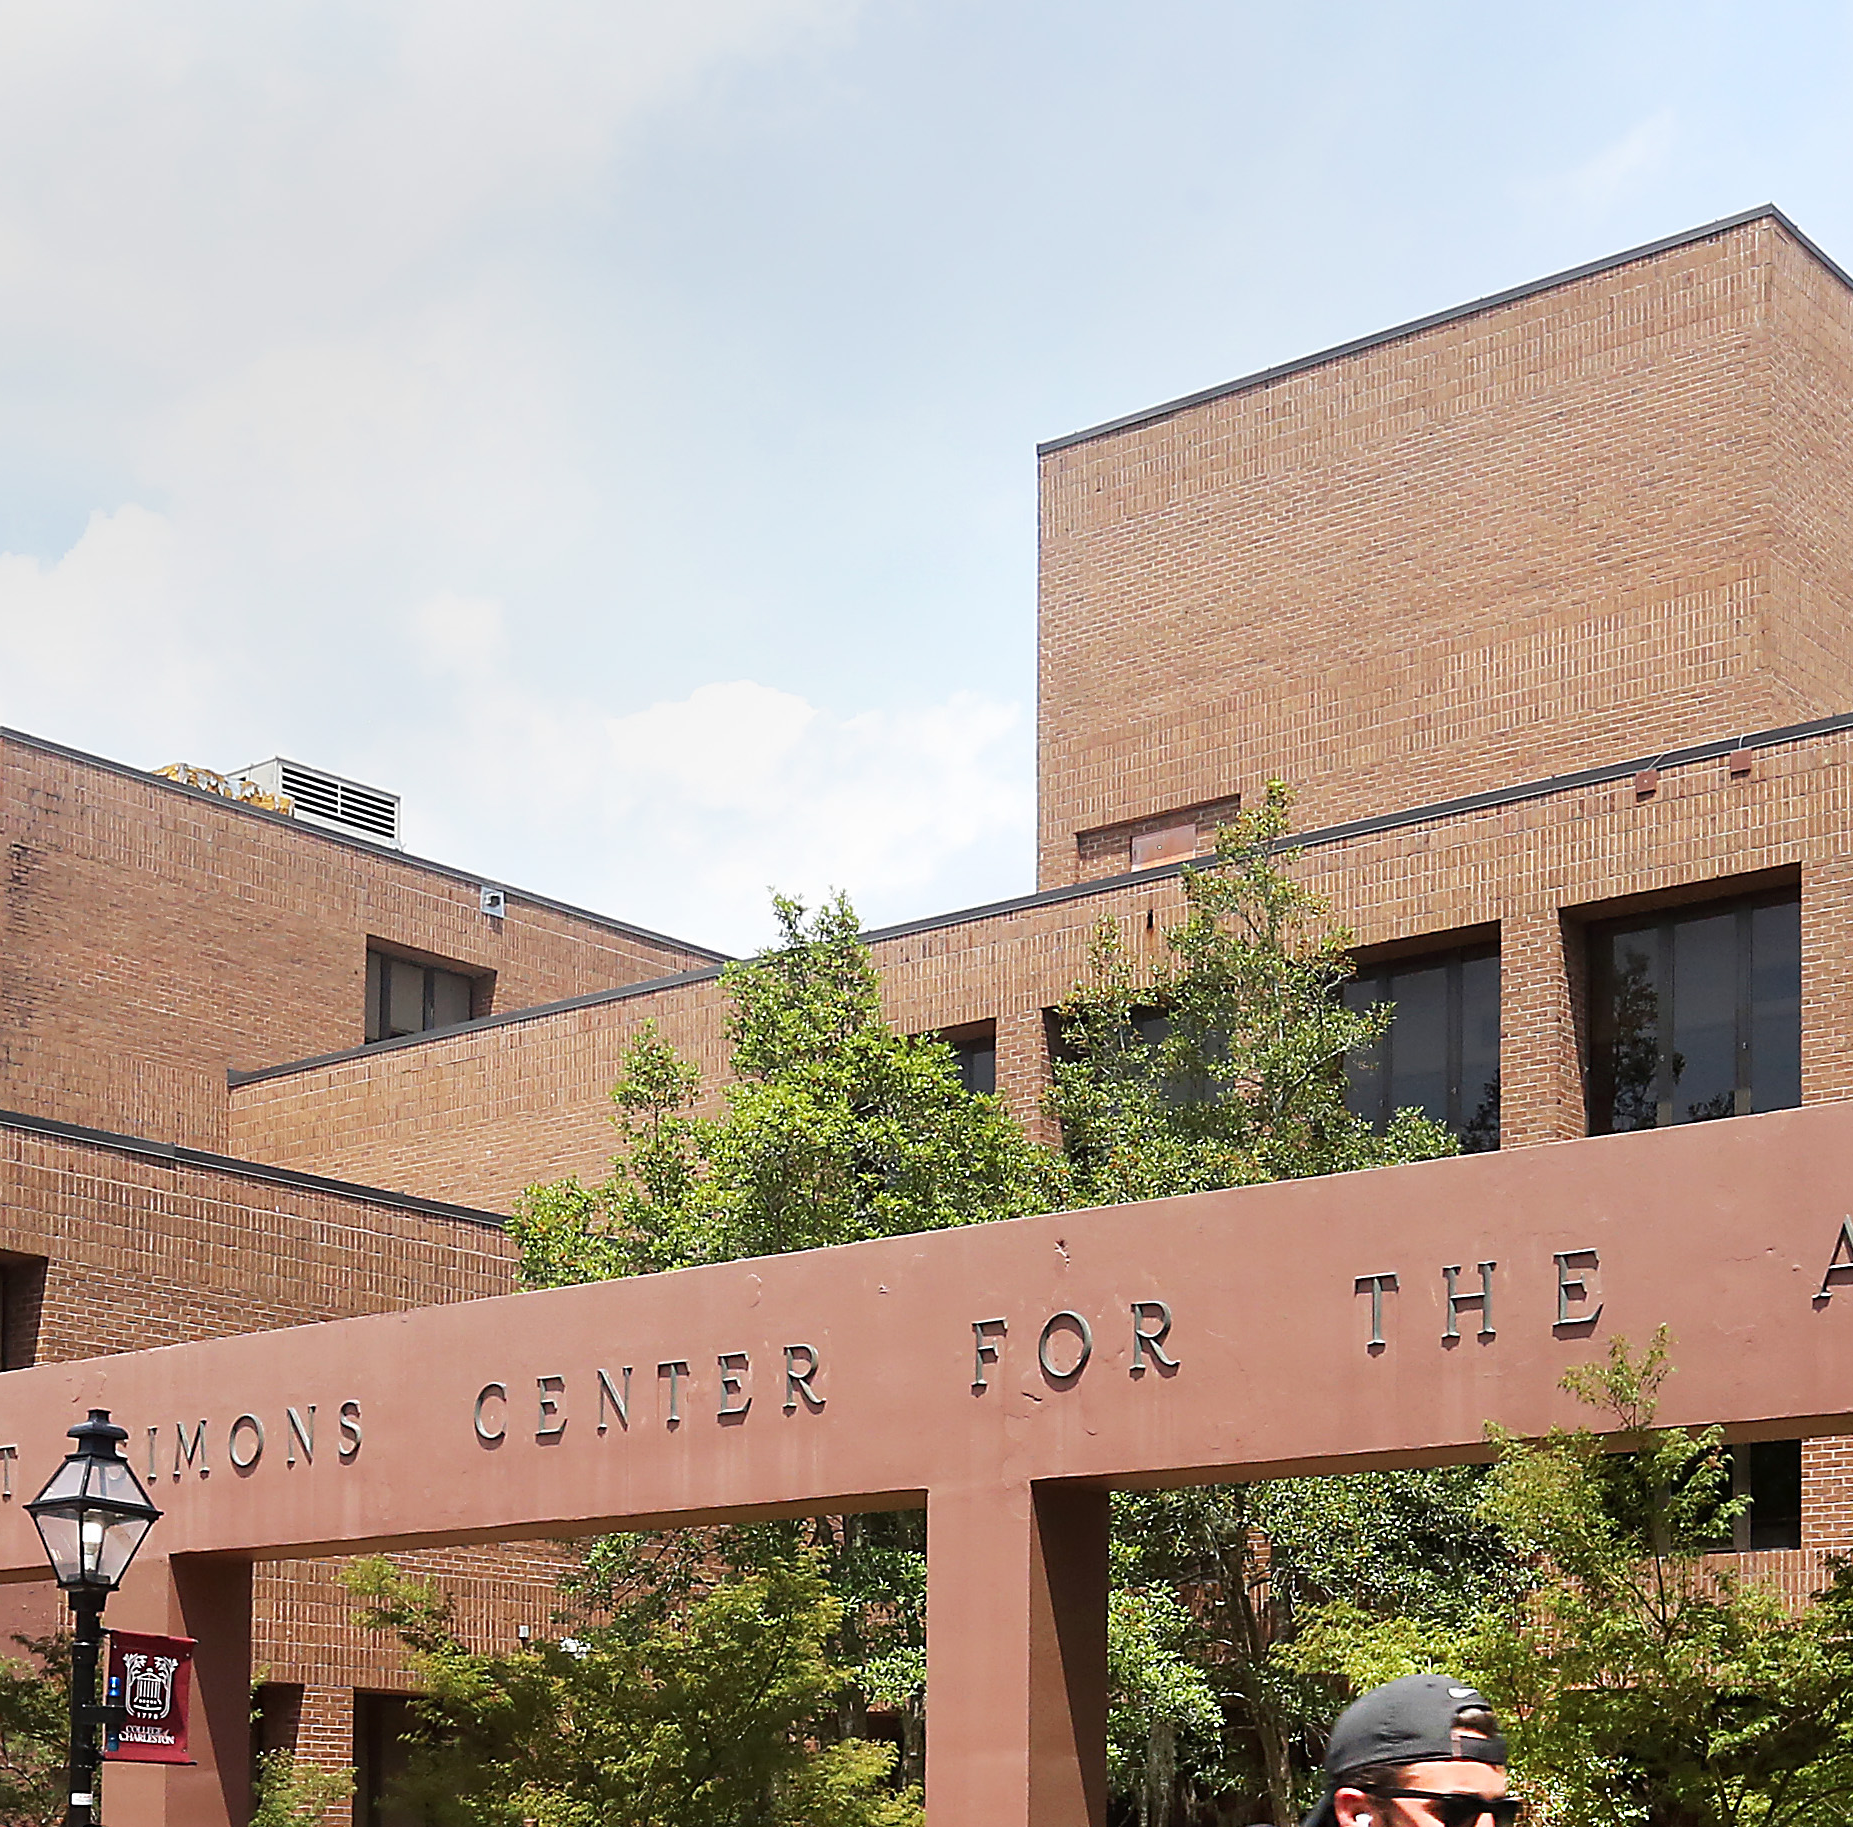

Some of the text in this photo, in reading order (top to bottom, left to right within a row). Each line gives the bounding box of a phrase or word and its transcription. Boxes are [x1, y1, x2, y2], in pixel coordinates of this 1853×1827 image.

[473, 1343, 826, 1441] CENTER
[971, 1300, 1180, 1387] FOR
[1355, 1248, 1604, 1351] THE
[119, 1731, 175, 1744] CHARLESTON
